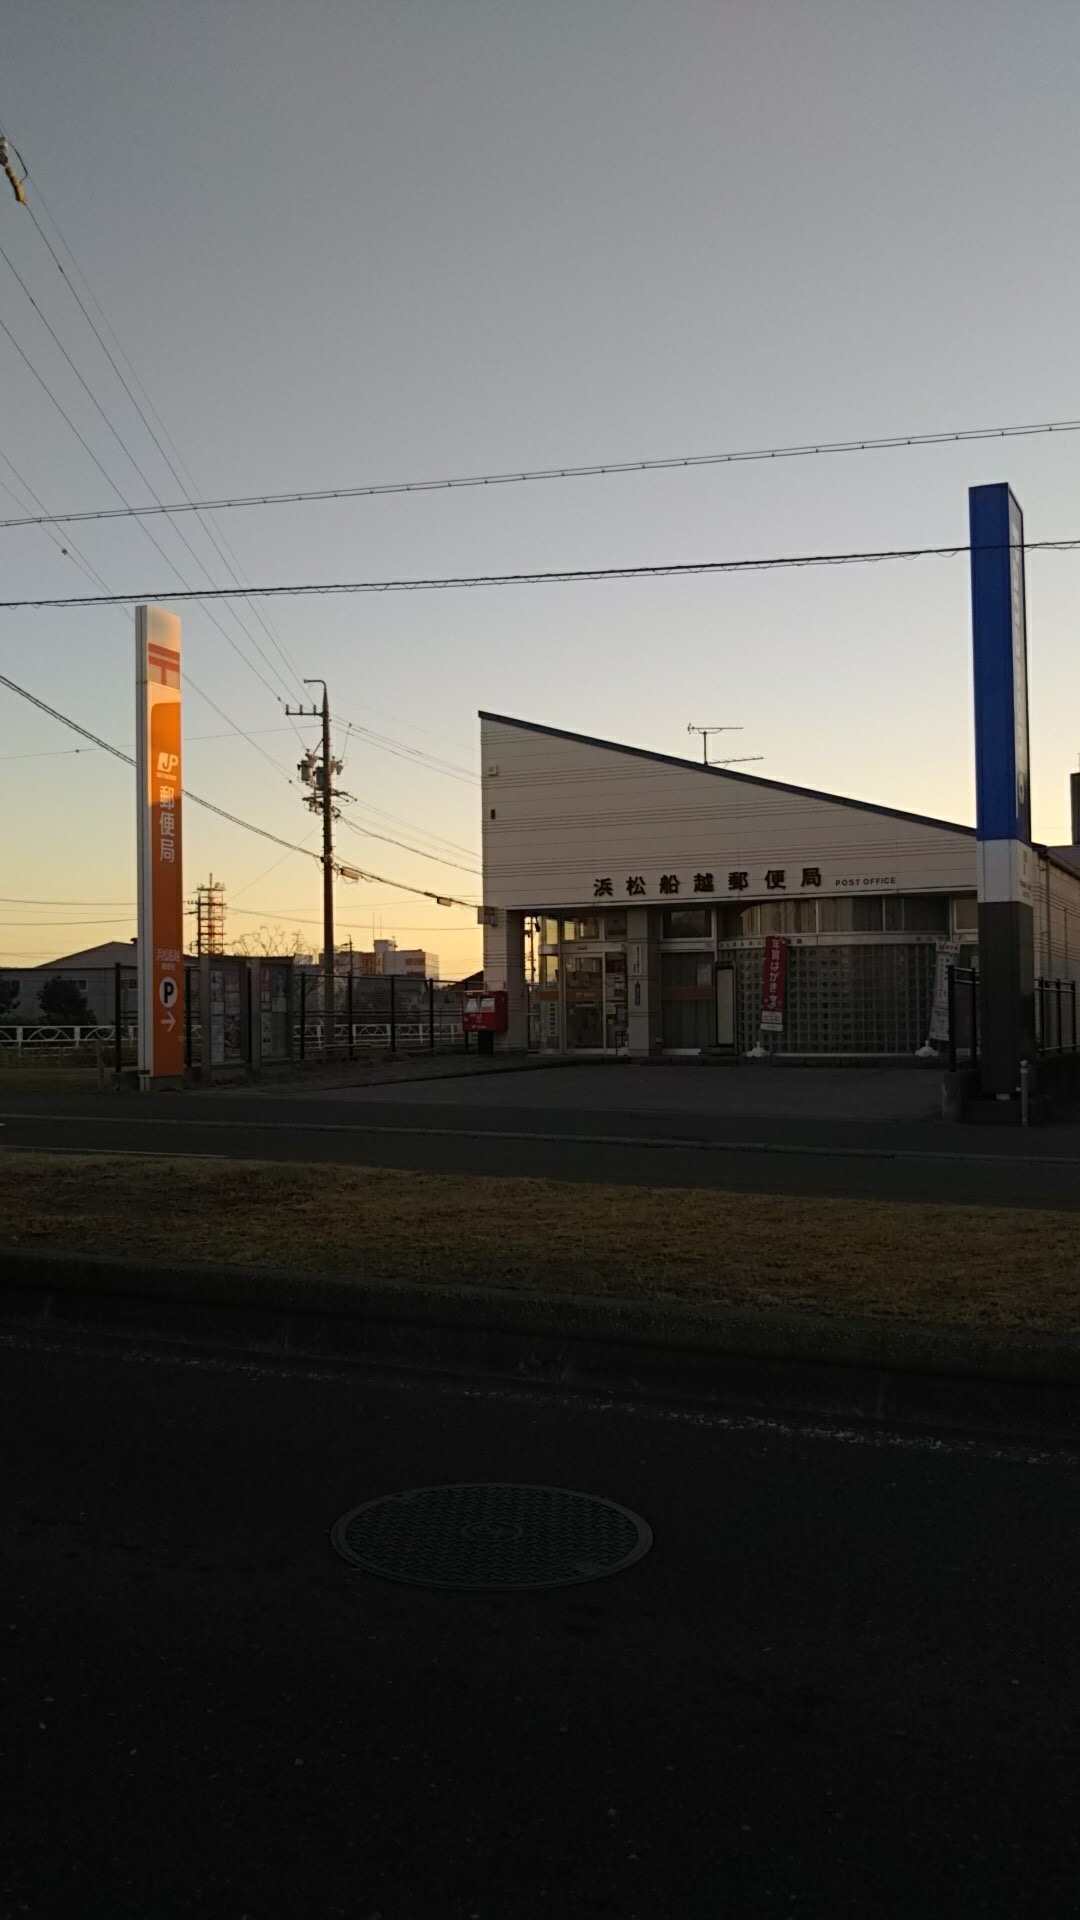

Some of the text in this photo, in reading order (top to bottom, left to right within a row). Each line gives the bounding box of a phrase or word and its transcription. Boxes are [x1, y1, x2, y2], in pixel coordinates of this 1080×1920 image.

[158, 785, 176, 863] 郵便局
[593, 867, 822, 897] 浜松船越郵便局
[835, 877, 896, 887] POST OFFICE
[164, 981, 174, 1003] P
